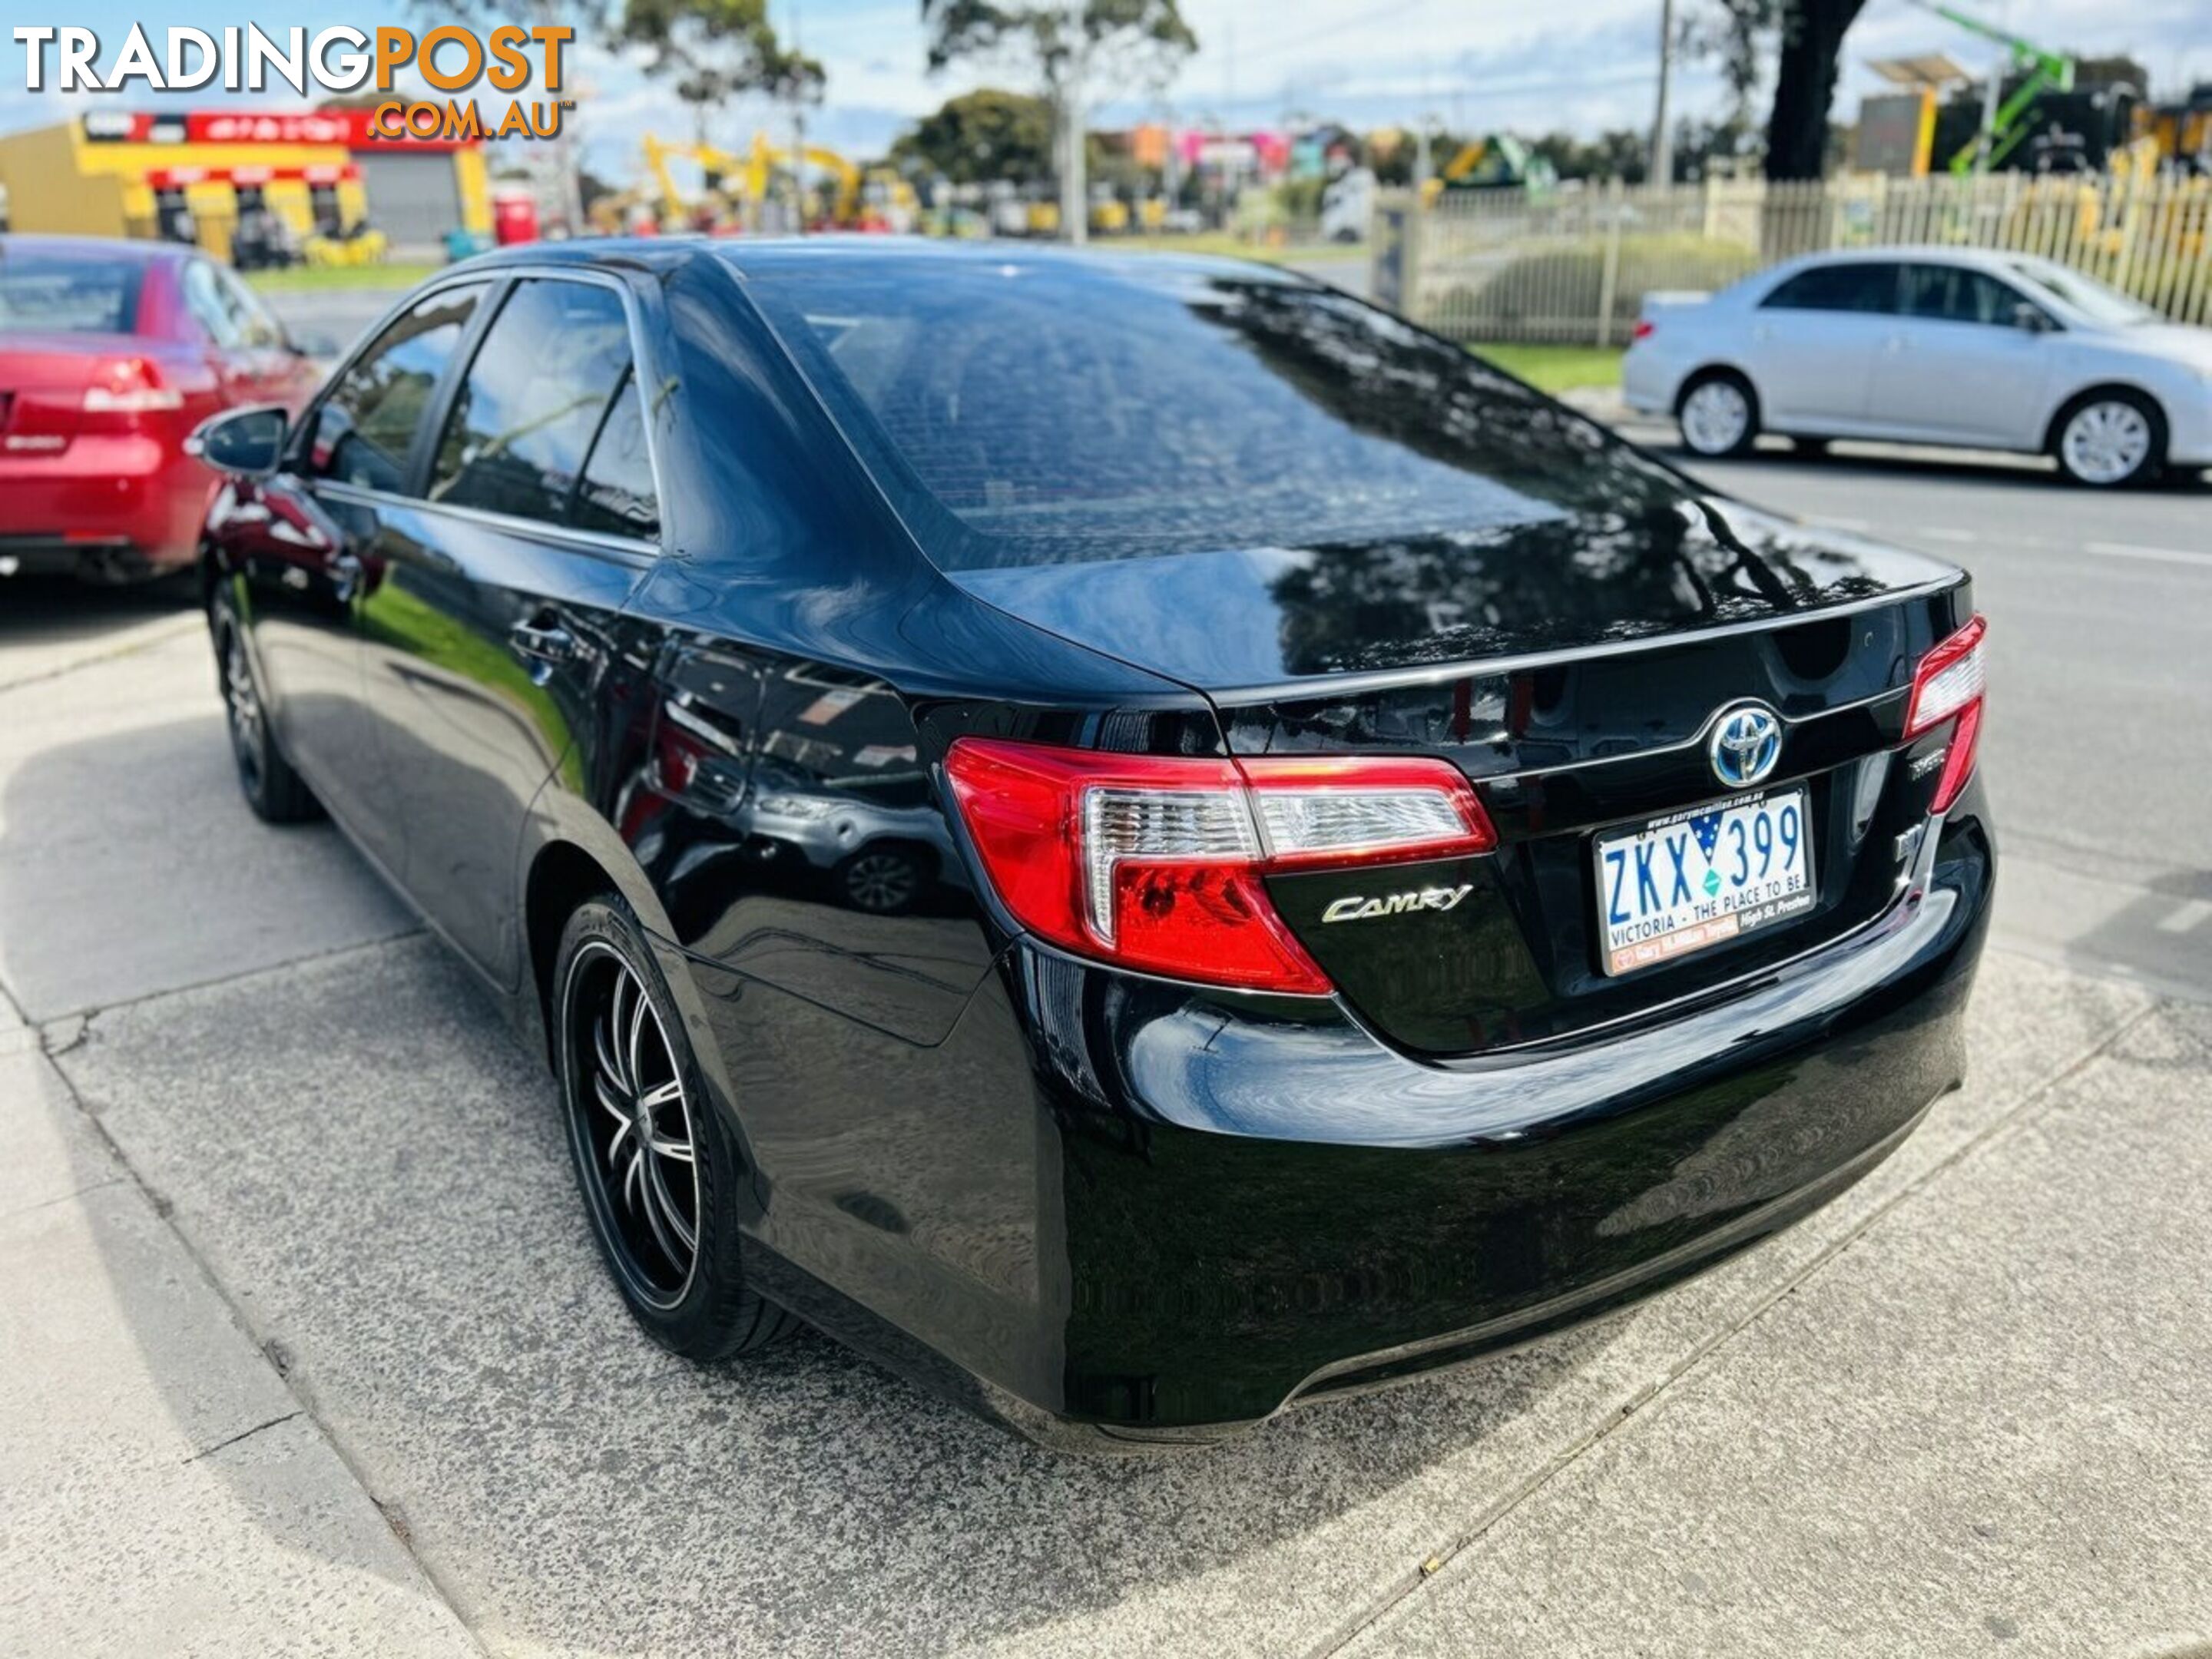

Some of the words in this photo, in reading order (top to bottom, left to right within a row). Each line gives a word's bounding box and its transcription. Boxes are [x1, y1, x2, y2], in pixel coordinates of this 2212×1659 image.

[1606, 833, 1692, 925] ZKX
[1727, 805, 1799, 887] 399
[1321, 884, 1474, 923] CAMRY
[1611, 914, 1675, 946] VICTORIA
[1694, 904, 1717, 921] THE
[1724, 886, 1760, 911] PLACE
[1766, 880, 1781, 898] TO
[1787, 873, 1800, 892] BE
